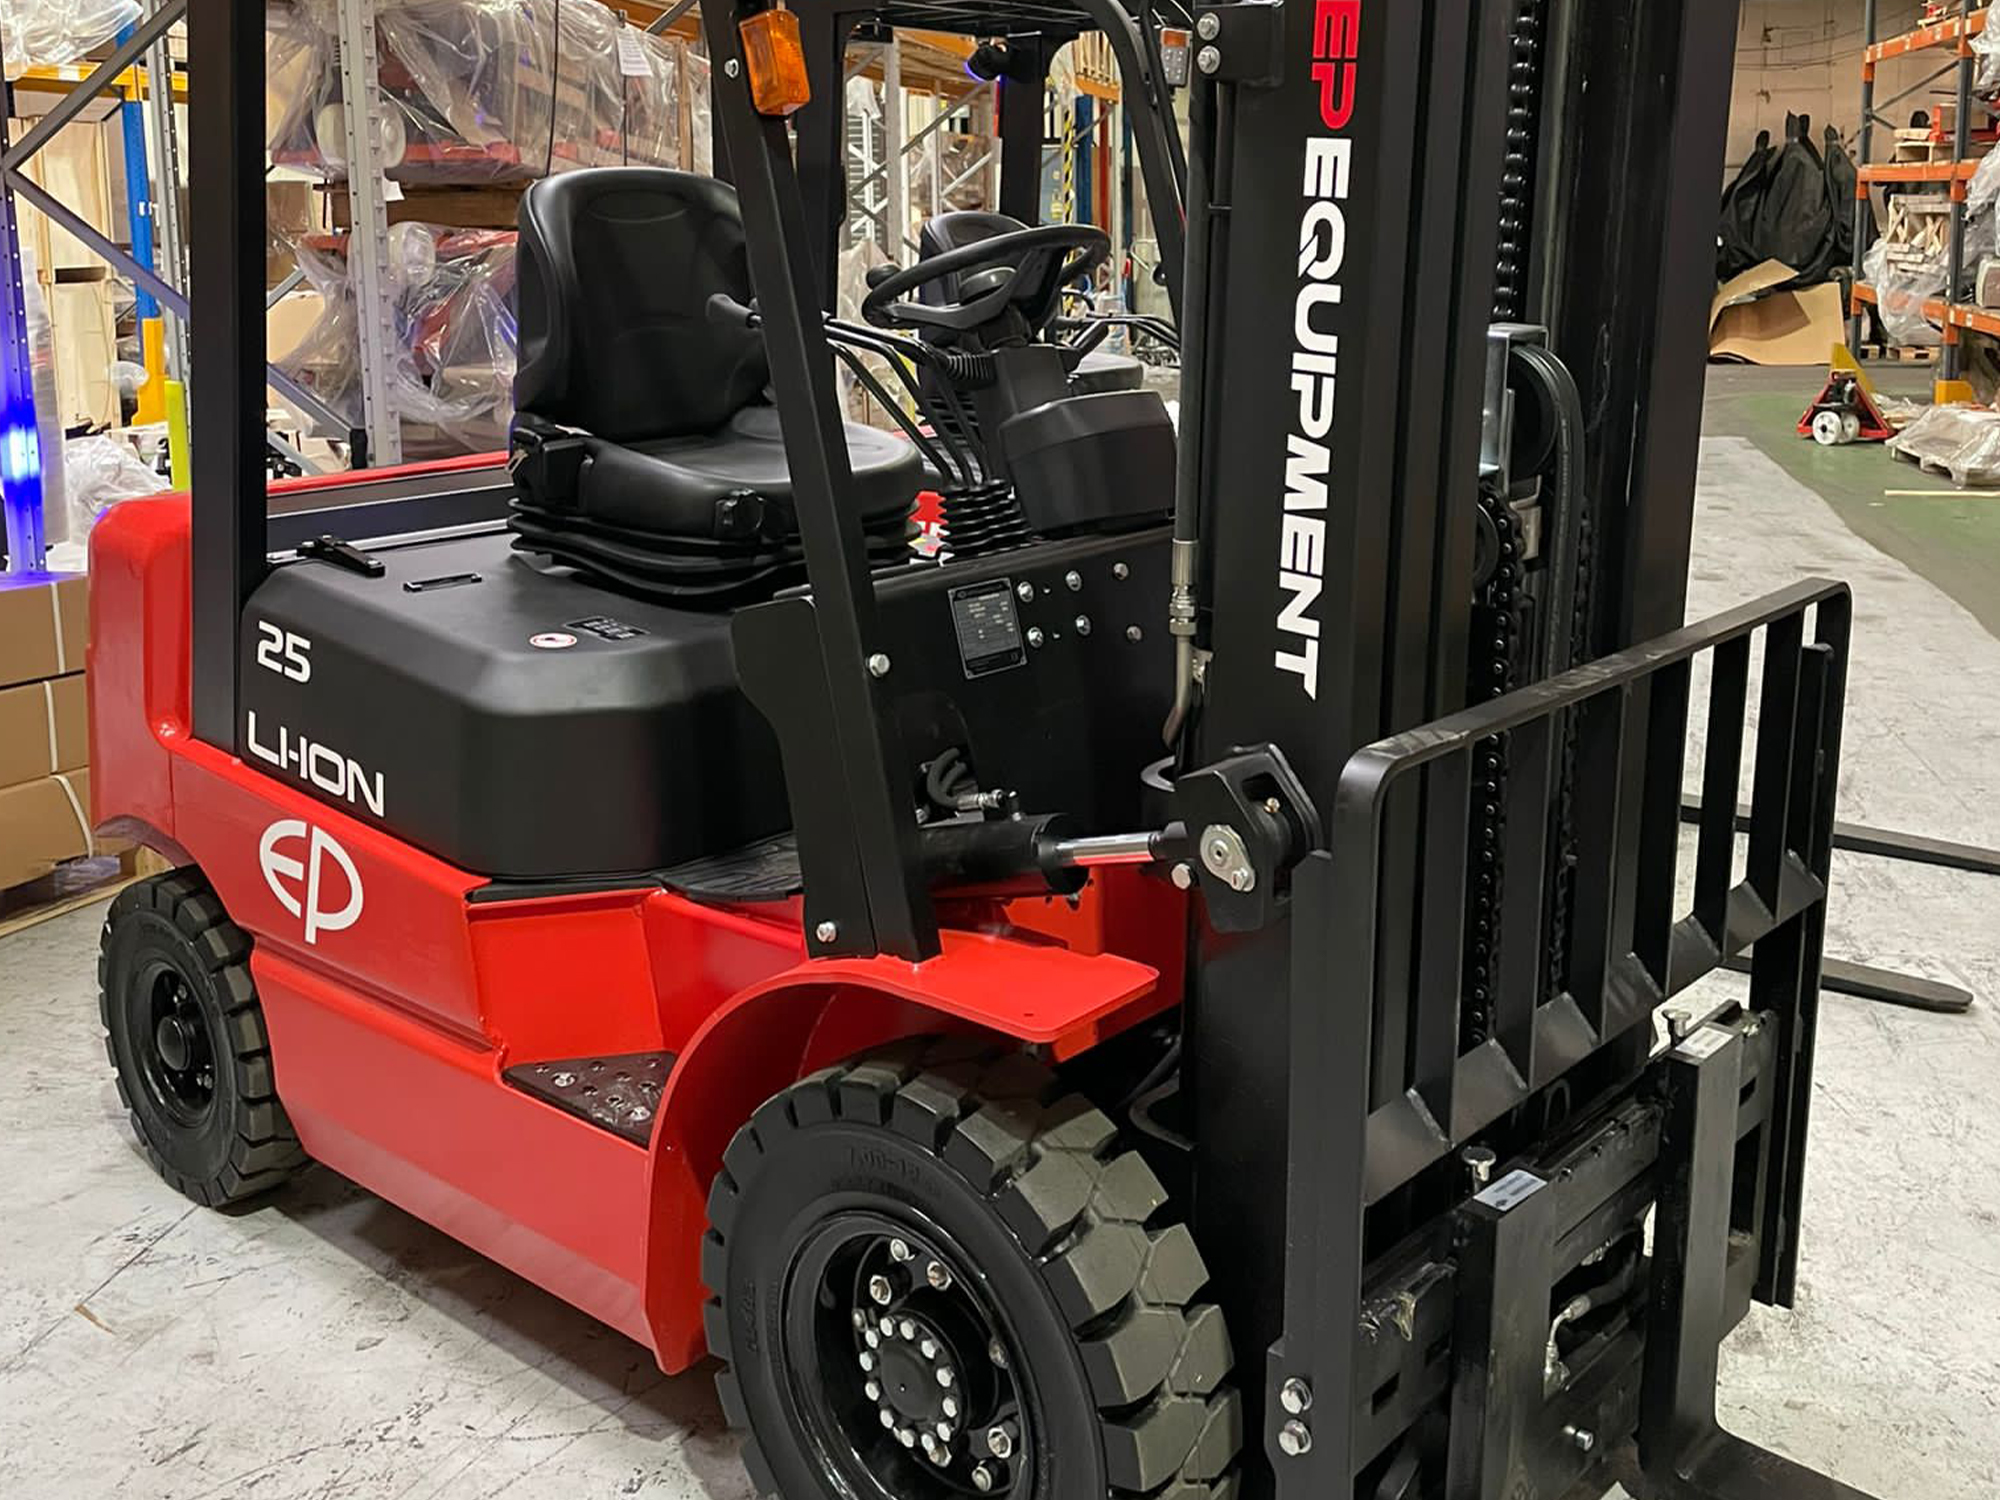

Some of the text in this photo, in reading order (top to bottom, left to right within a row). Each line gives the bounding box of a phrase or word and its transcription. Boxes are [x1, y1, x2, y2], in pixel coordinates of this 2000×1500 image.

[1275, 0, 1361, 700] EP EQUIPMENT
[257, 620, 312, 683] 25
[248, 711, 384, 817] LI-ION
[259, 819, 364, 945] EP
